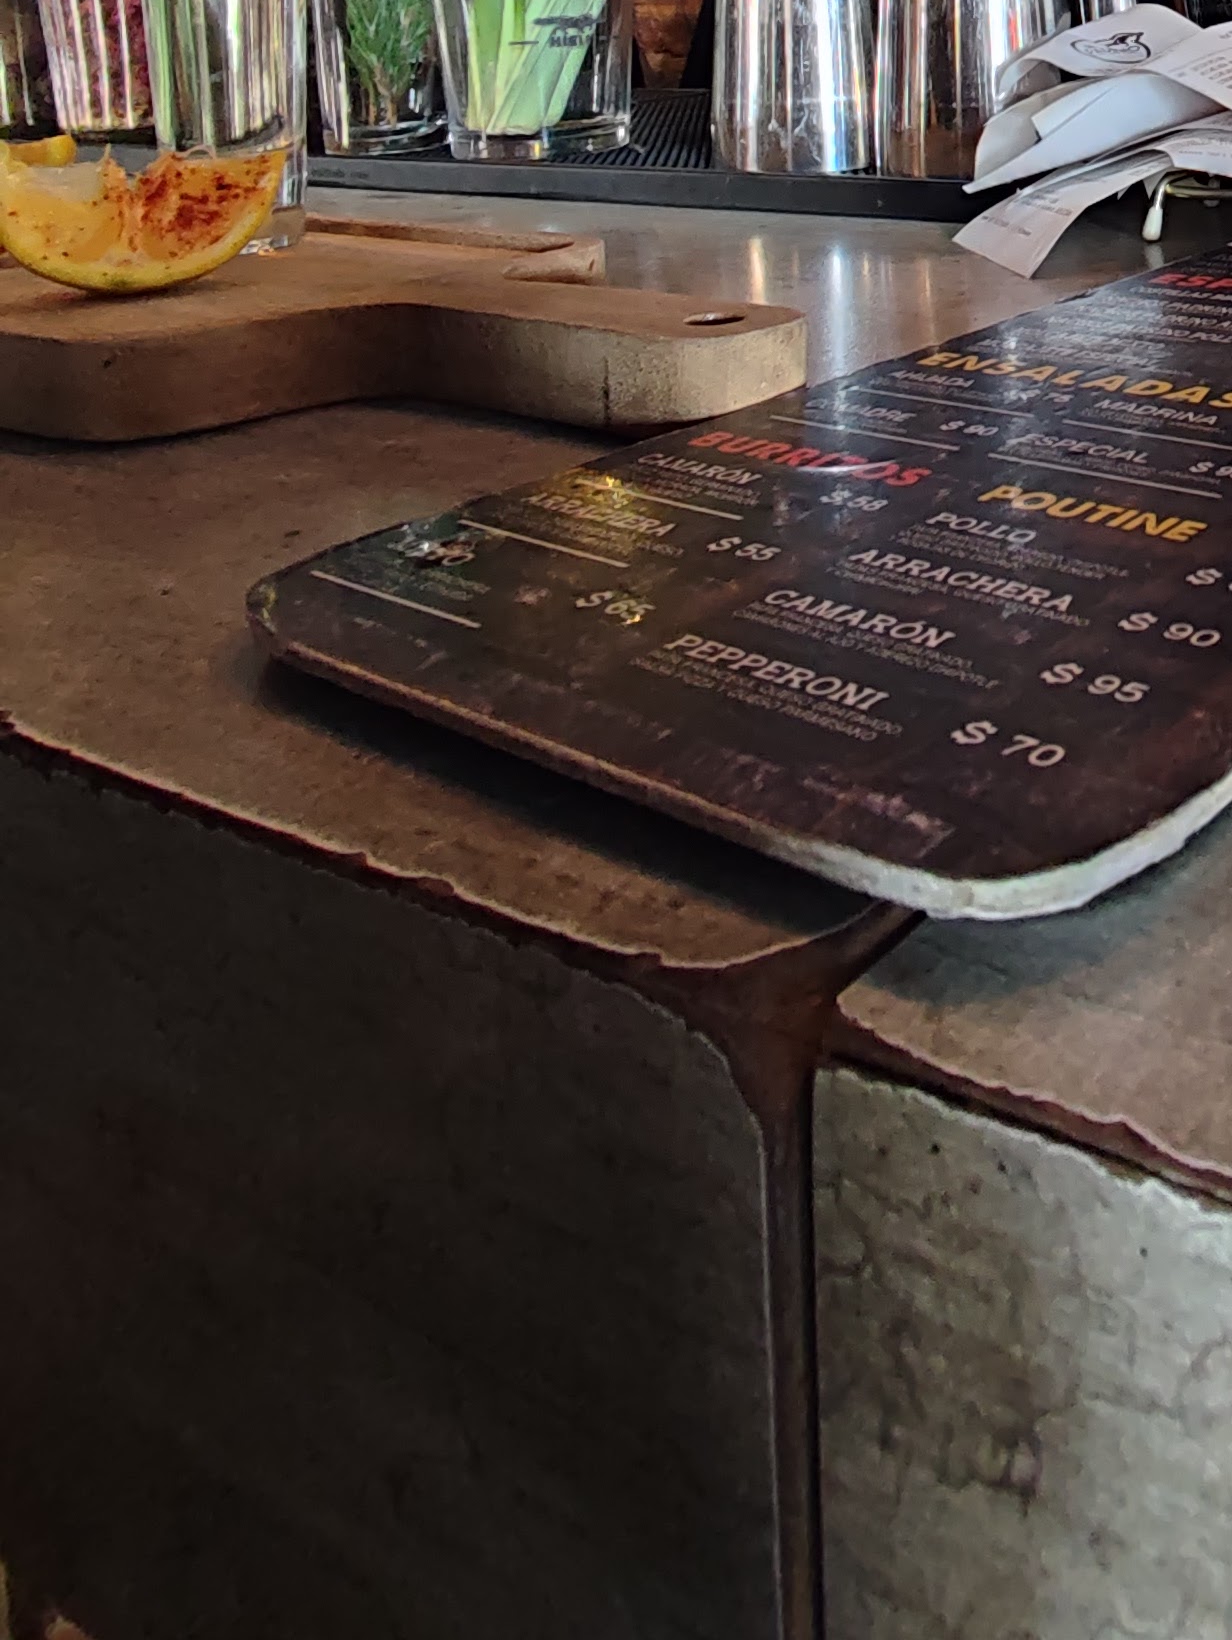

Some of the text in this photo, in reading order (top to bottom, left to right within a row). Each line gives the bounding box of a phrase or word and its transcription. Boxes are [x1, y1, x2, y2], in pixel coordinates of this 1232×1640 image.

[939, 420, 966, 431] $
[963, 424, 1000, 437] 90
[1097, 399, 1220, 426] MADRINA
[637, 453, 764, 485] CAMARÓN
[848, 493, 890, 512] 58
[1005, 433, 1149, 465] ESPECIAL
[1188, 461, 1215, 474] $
[521, 492, 677, 538] ARRACHERA
[705, 536, 742, 553] $
[735, 542, 783, 562] 55
[977, 484, 1208, 543] POUTINE
[925, 511, 1038, 544] POLLO
[1185, 567, 1224, 587] $
[575, 590, 613, 609] $
[848, 549, 1073, 612] ARRACHERA
[1117, 610, 1160, 632] $
[1161, 621, 1221, 648] 90
[763, 589, 956, 649] CAMARÓN
[1039, 661, 1086, 685] $
[1087, 673, 1152, 704] 95
[662, 634, 891, 712] PEPPERONI
[950, 720, 999, 746] $
[1000, 734, 1067, 768] 70
